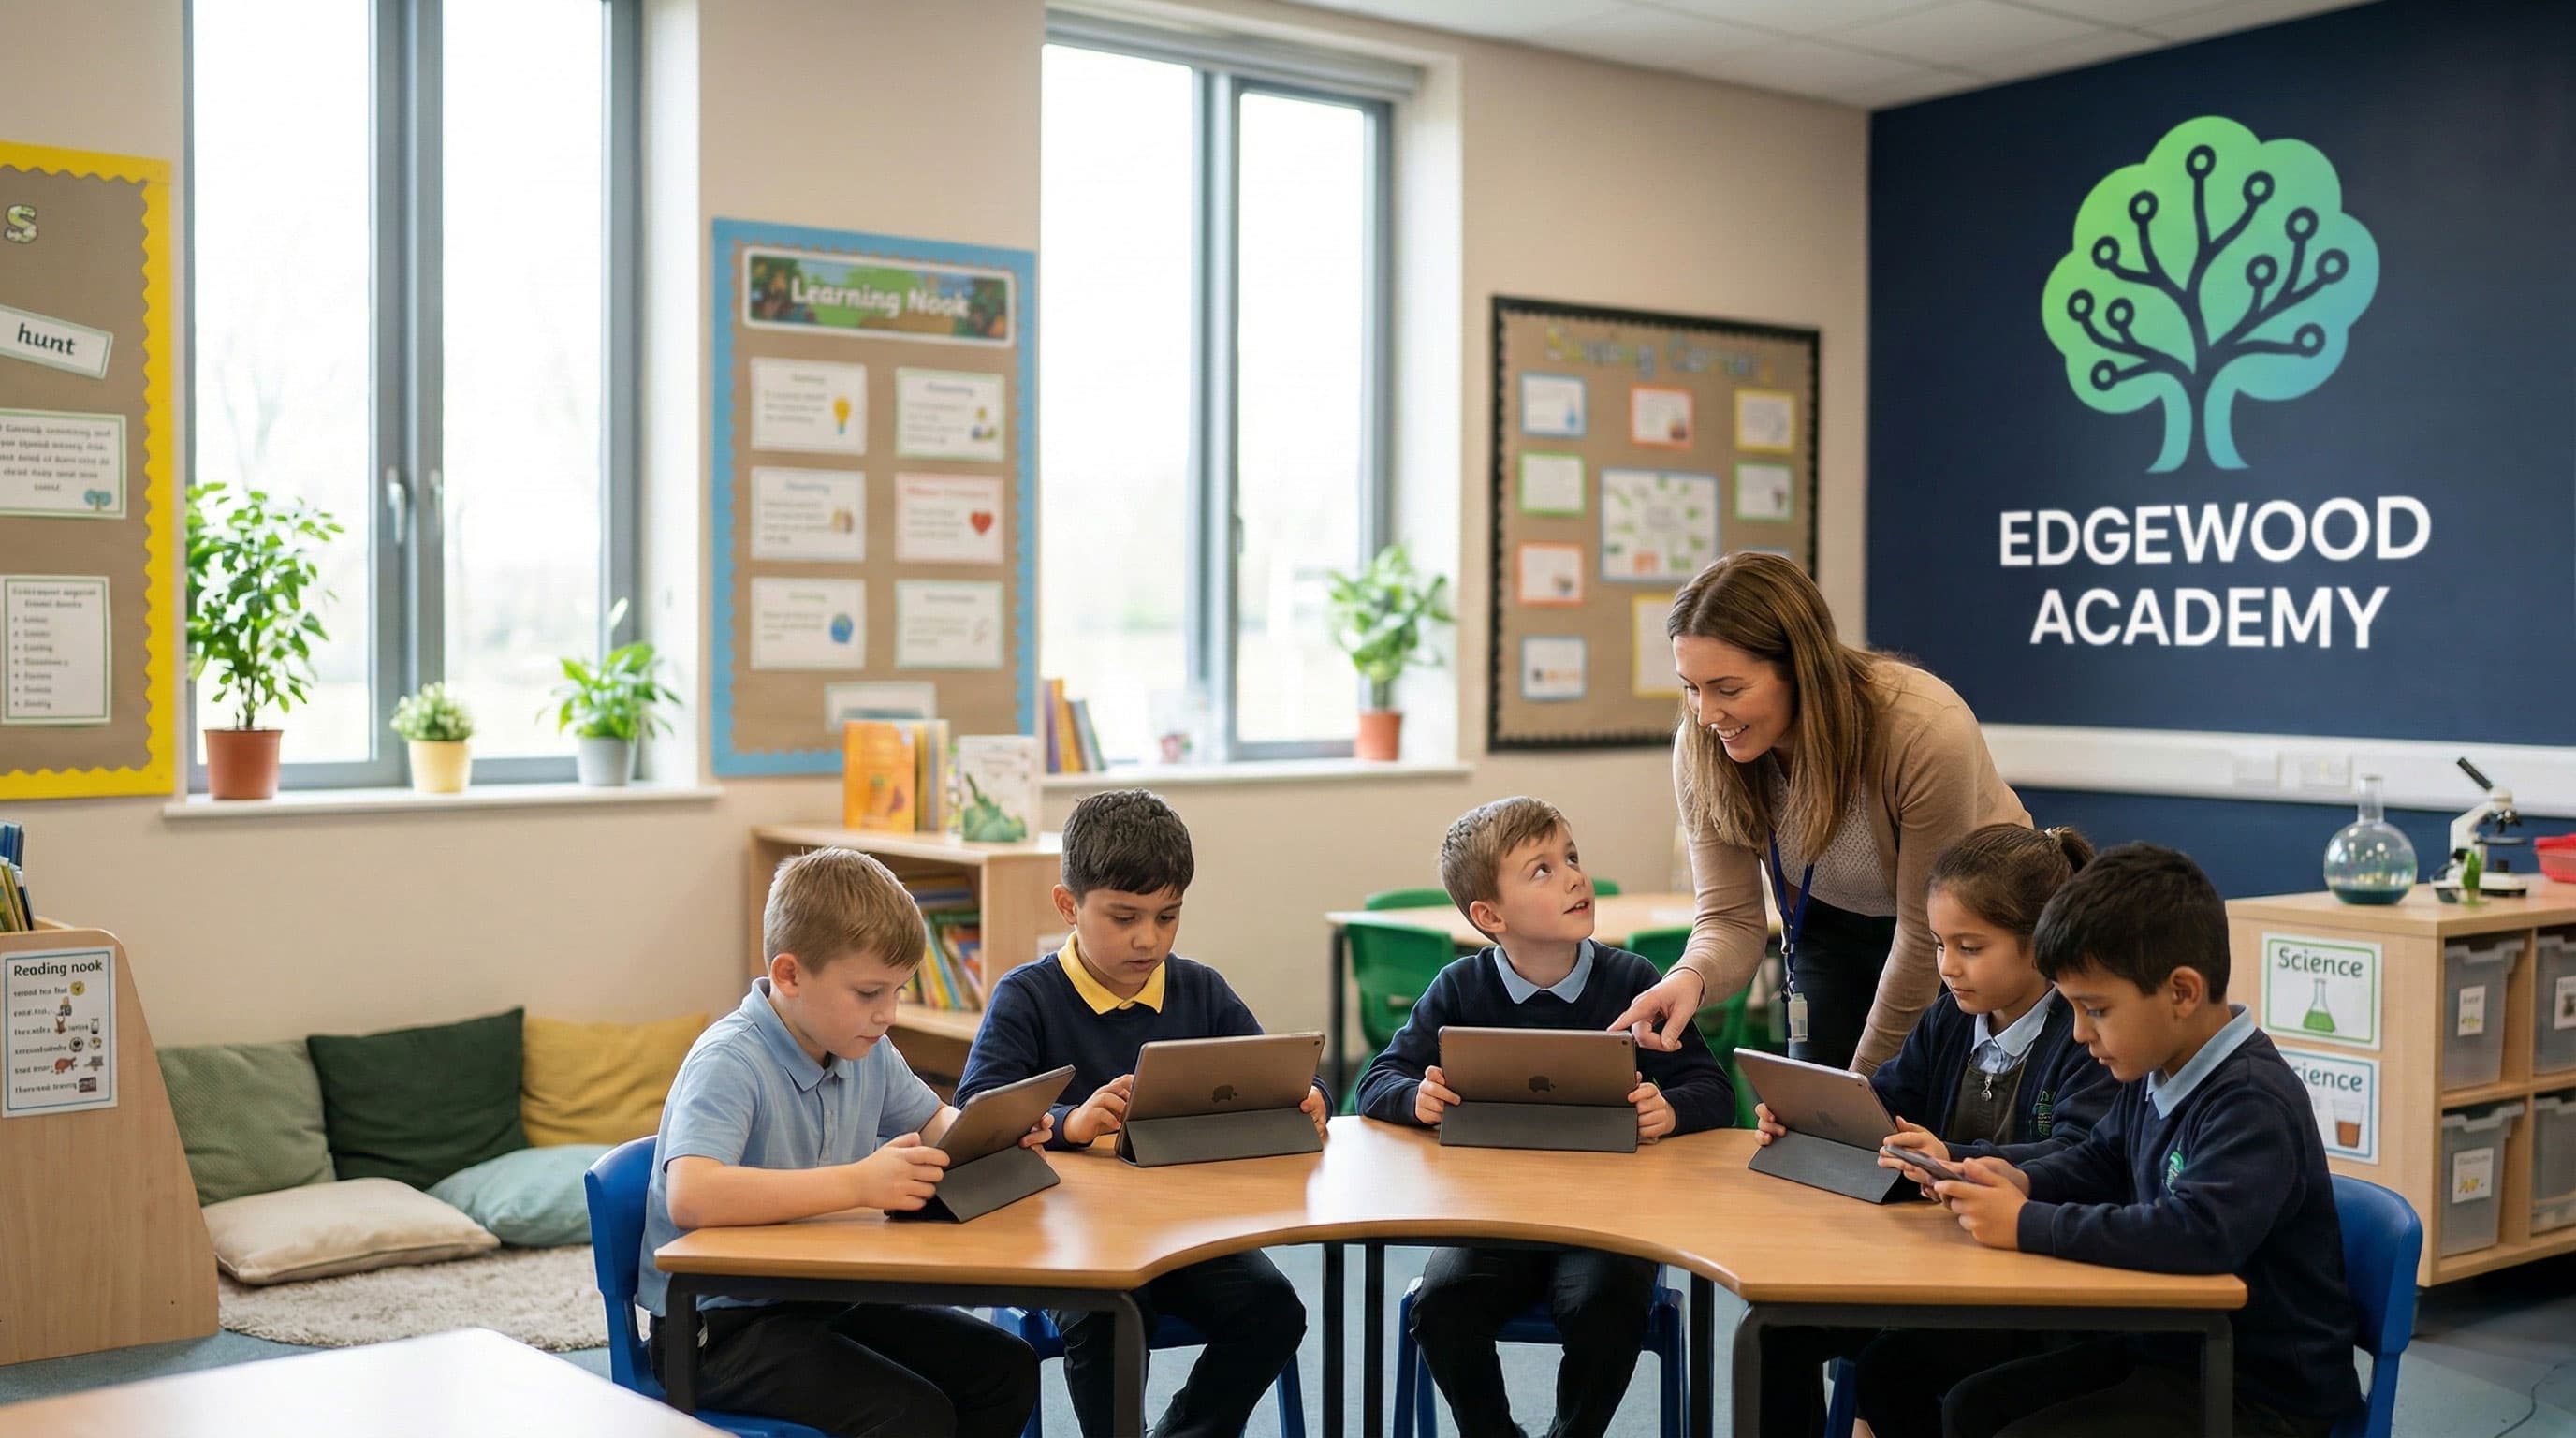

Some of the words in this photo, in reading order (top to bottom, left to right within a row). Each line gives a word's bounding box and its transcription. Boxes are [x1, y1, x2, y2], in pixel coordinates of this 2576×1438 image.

[791, 275, 901, 319] Learning
[906, 287, 969, 317] Nook
[17, 322, 76, 355] hunt
[1999, 495, 2432, 566] EDGEWOOD
[2029, 586, 2391, 649] ACADEMY
[14, 961, 66, 977] Reading
[71, 959, 103, 974] nook
[2277, 946, 2364, 978] Science
